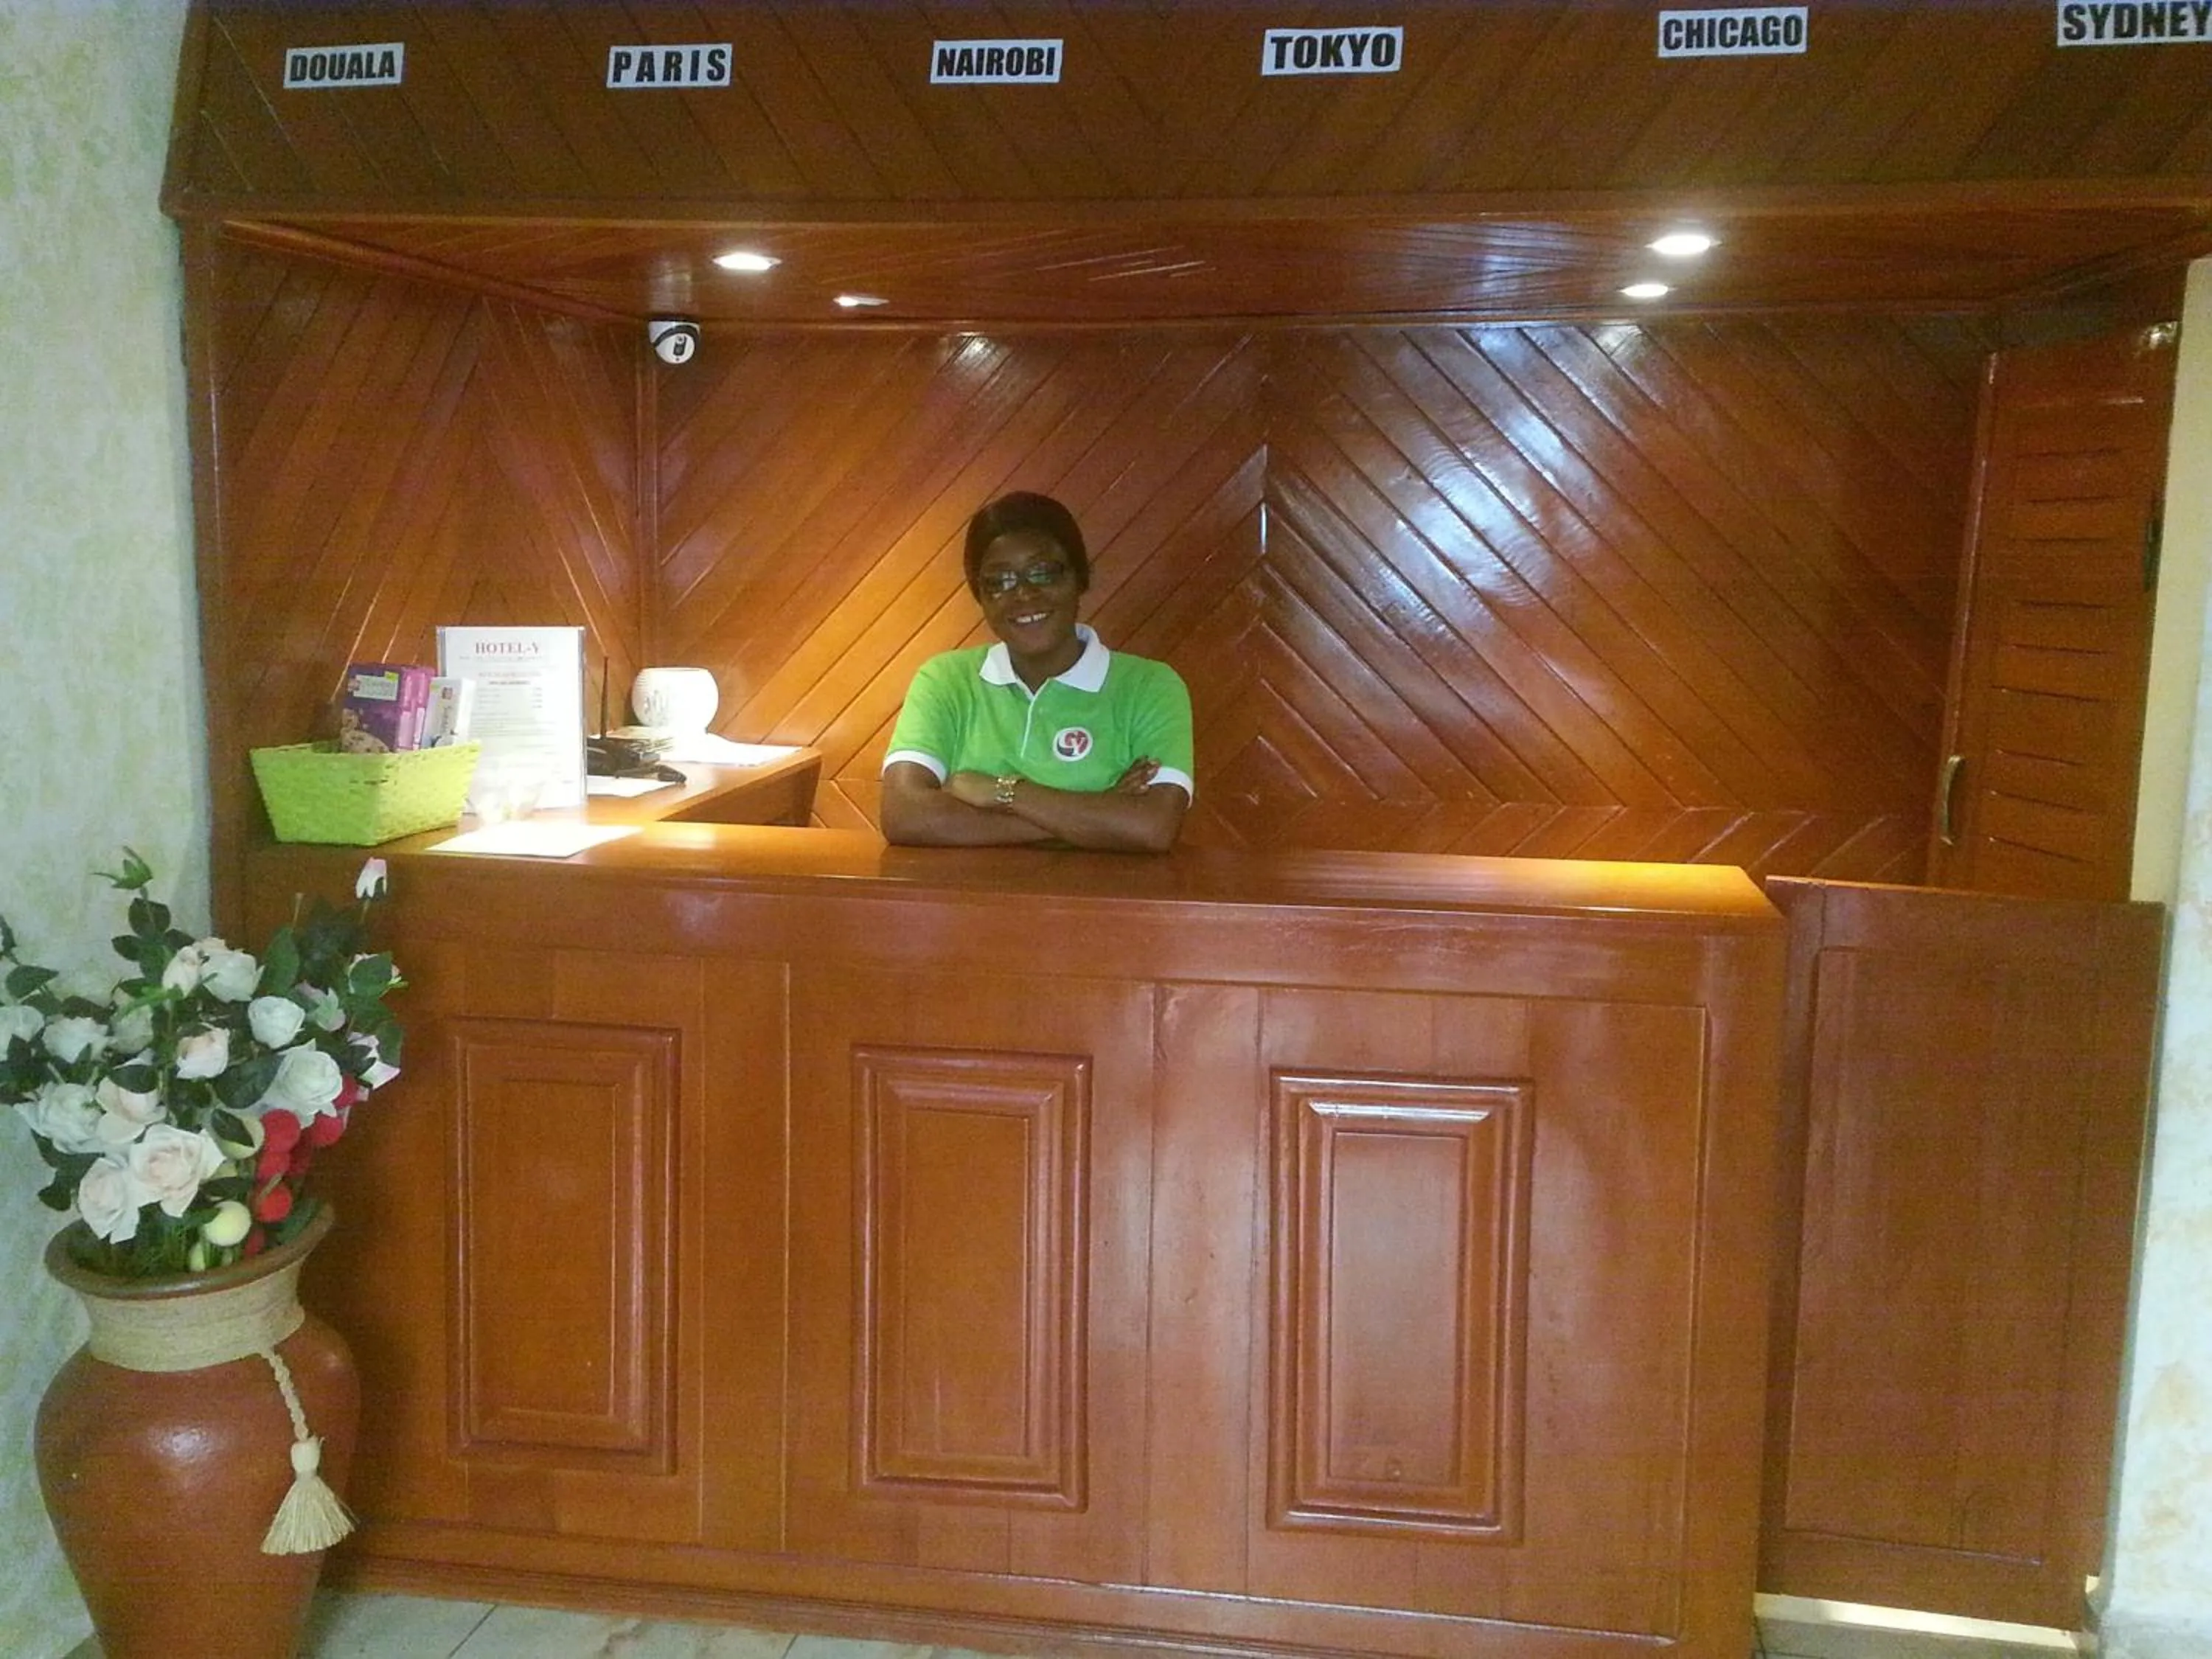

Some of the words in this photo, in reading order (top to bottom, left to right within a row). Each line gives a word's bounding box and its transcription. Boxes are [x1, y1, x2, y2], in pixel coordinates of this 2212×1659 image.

[1663, 15, 1803, 50] CHICAGO
[2064, 1, 2212, 40] SYDNEY
[290, 50, 394, 81] DOUALA
[613, 49, 726, 83] PARIS
[936, 46, 1056, 77] NAIROBI
[1270, 33, 1396, 69] TOKYO
